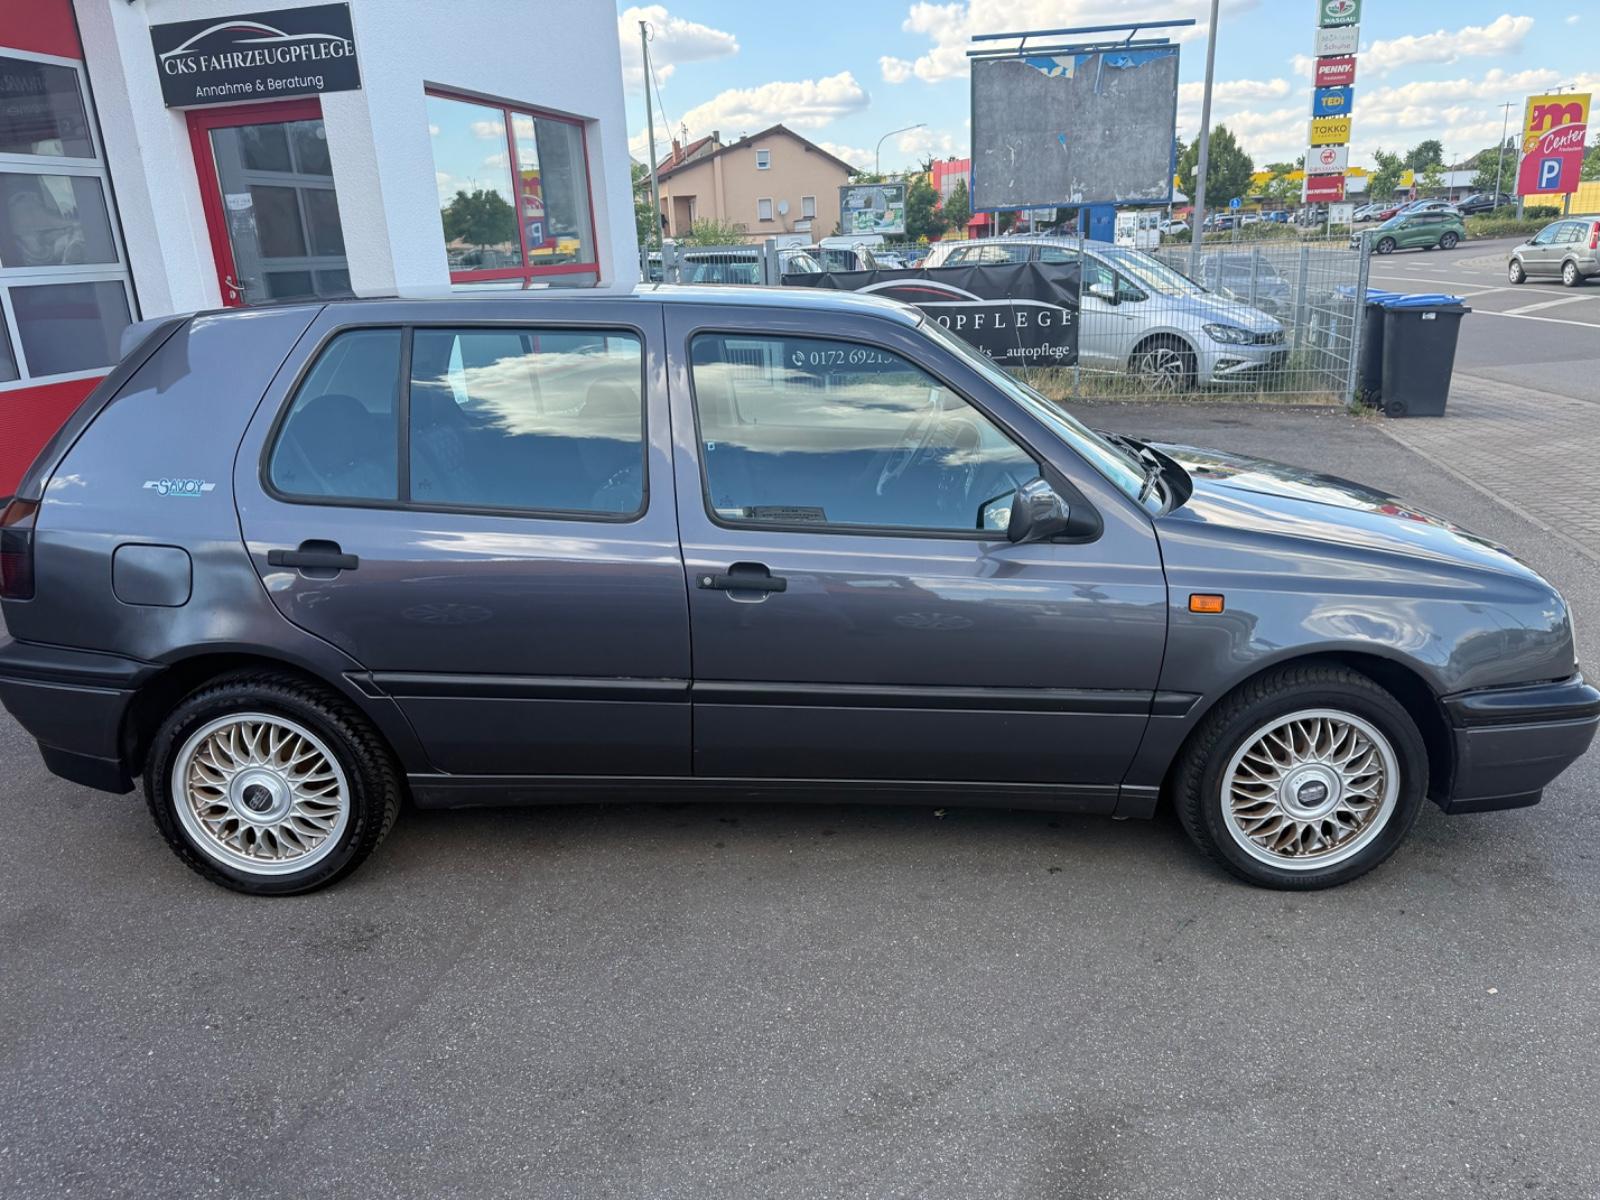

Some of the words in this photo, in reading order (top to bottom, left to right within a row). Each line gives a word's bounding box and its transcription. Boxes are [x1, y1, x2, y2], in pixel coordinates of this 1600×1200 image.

[164, 56, 197, 75] CKS
[200, 40, 355, 72] FAHRZEUGPFLEGE
[195, 80, 253, 98] Annahme
[256, 79, 265, 92] &
[267, 74, 324, 90] Beratung
[1314, 124, 1348, 134] TOKKO
[1543, 129, 1585, 154] Center
[1541, 160, 1560, 188] P
[810, 350, 845, 365] 0172
[151, 479, 205, 496] SAVOY
